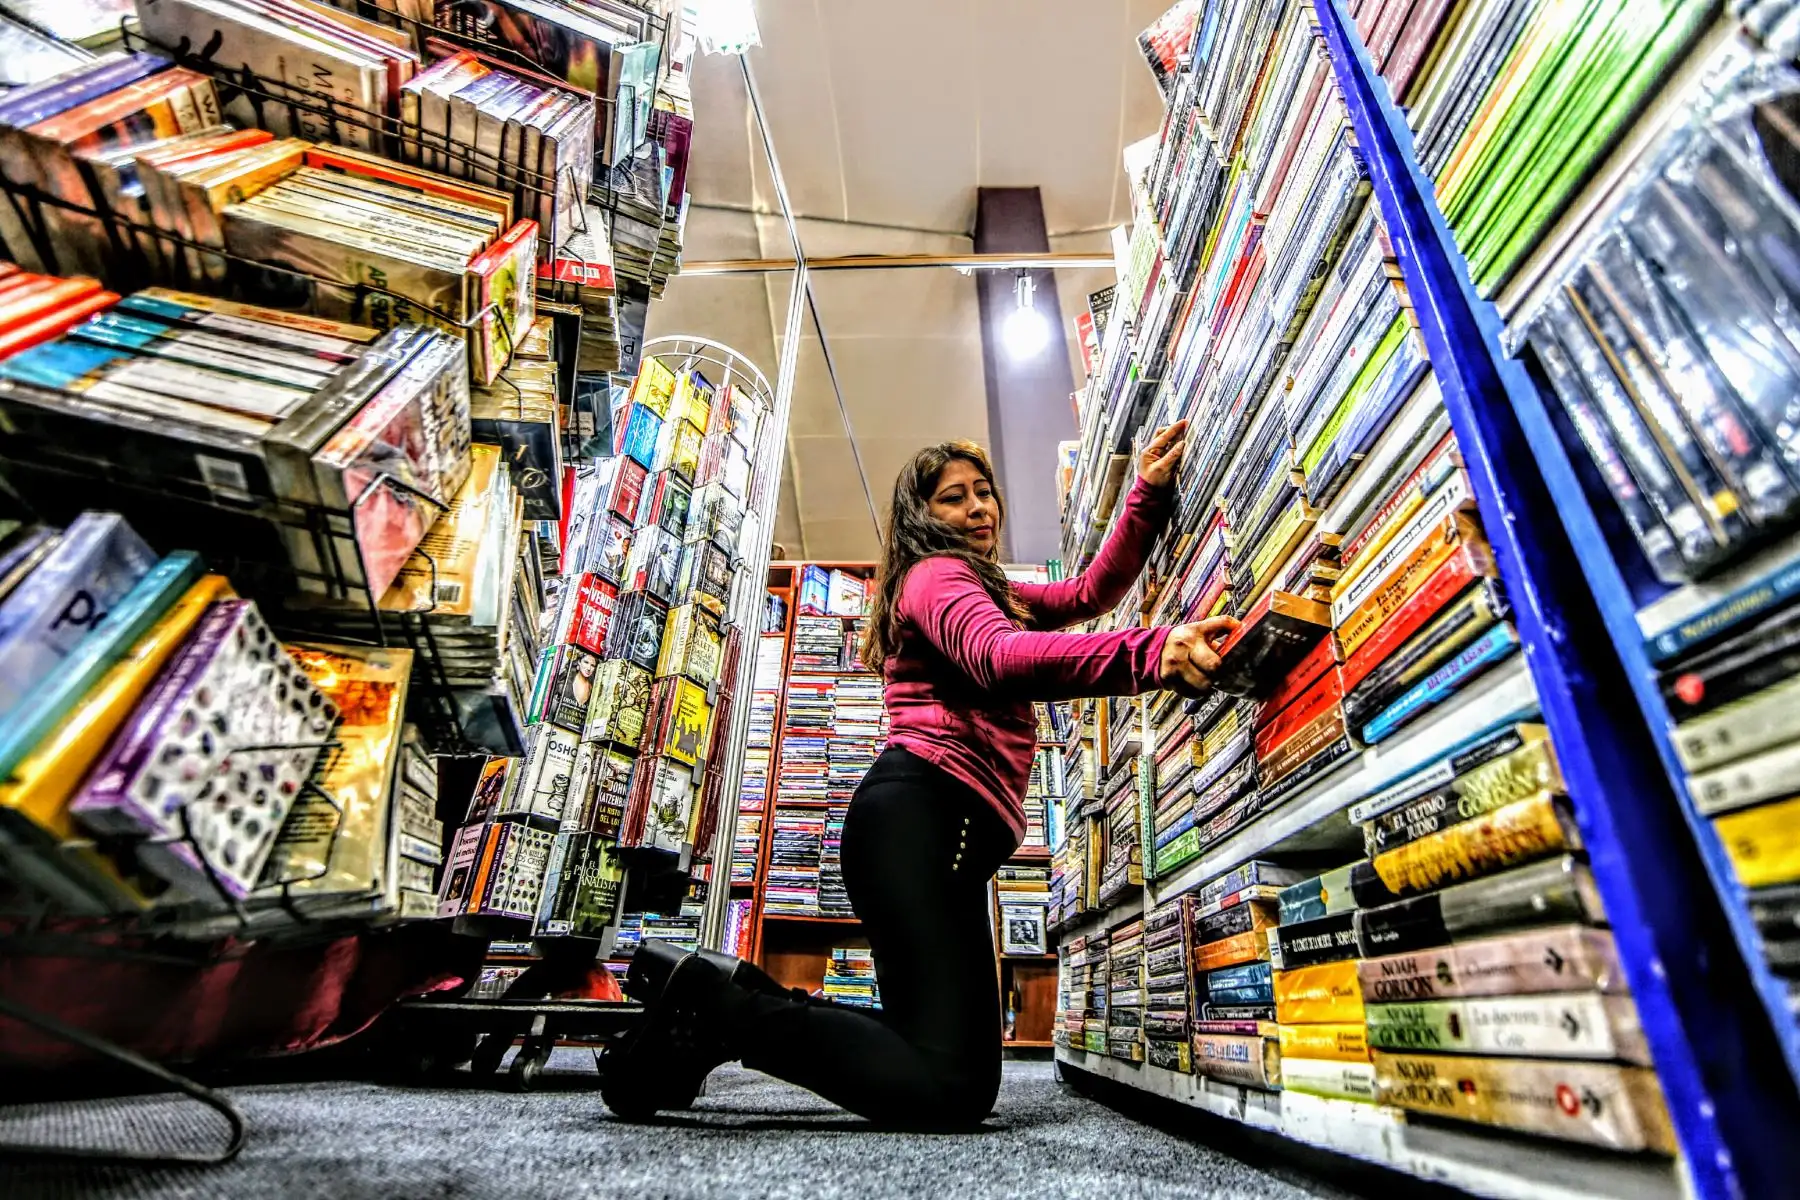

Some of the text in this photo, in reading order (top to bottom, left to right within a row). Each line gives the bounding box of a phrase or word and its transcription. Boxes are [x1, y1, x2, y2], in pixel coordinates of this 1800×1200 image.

[549, 740, 579, 758] OSHO
[608, 781, 627, 796] JOHN
[1393, 815, 1407, 832] EL
[1463, 759, 1514, 792] NOAH
[1457, 771, 1537, 820] GORDON
[589, 860, 596, 868] EL
[1380, 957, 1418, 976] NOAH
[1373, 976, 1434, 1000] GORDON
[1385, 1006, 1426, 1026] NOAH
[1379, 1023, 1441, 1048] GORDON
[1396, 1061, 1437, 1080] NOAH
[1391, 1084, 1455, 1107] GORDON
